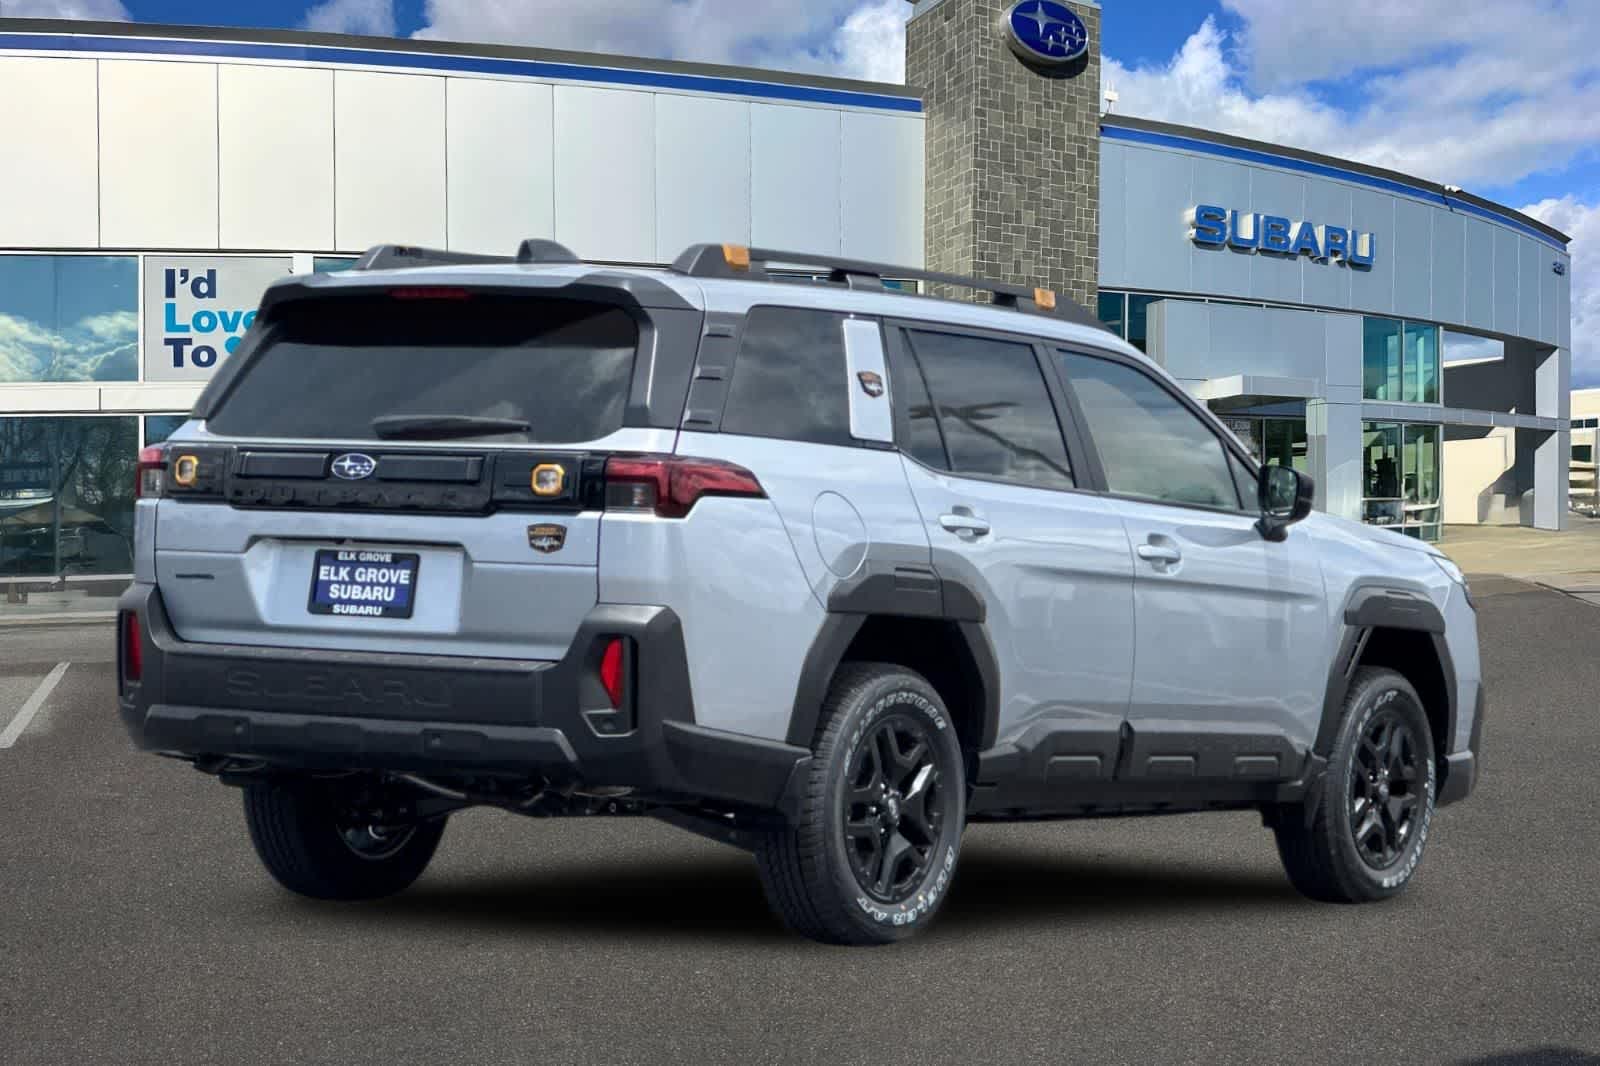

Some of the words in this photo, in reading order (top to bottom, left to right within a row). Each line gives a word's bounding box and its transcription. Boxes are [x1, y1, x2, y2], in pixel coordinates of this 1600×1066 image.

[1191, 204, 1376, 267] SUBARU
[164, 337, 217, 368] To
[338, 551, 356, 561] ELK
[359, 552, 392, 562] GROVE
[319, 565, 351, 581] ELK
[355, 567, 411, 584] GROVE
[329, 583, 395, 602] SUBARU
[332, 603, 382, 615] SUBARU
